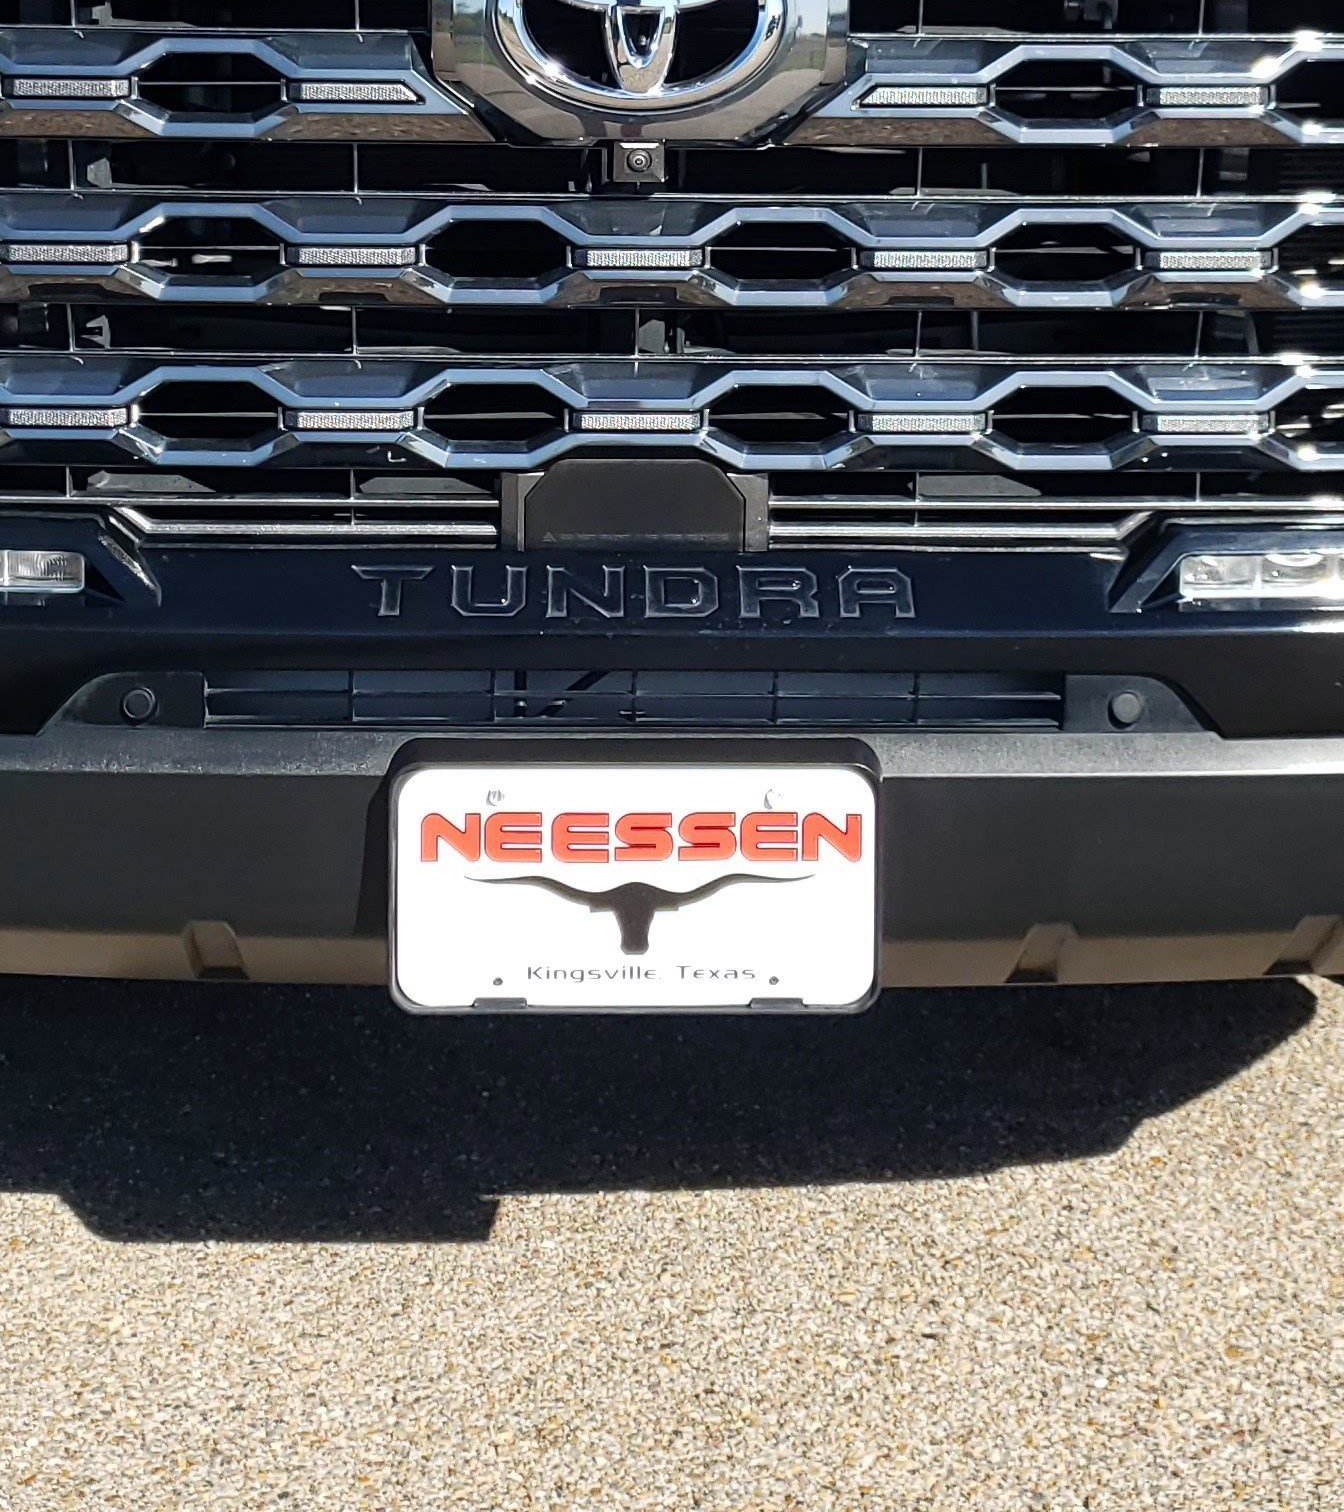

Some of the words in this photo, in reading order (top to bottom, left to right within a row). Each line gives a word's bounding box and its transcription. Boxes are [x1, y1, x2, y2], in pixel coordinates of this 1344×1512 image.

[351, 564, 917, 619] TUNDRA
[420, 811, 863, 863] NEESSEN
[675, 965, 756, 980] Texas
